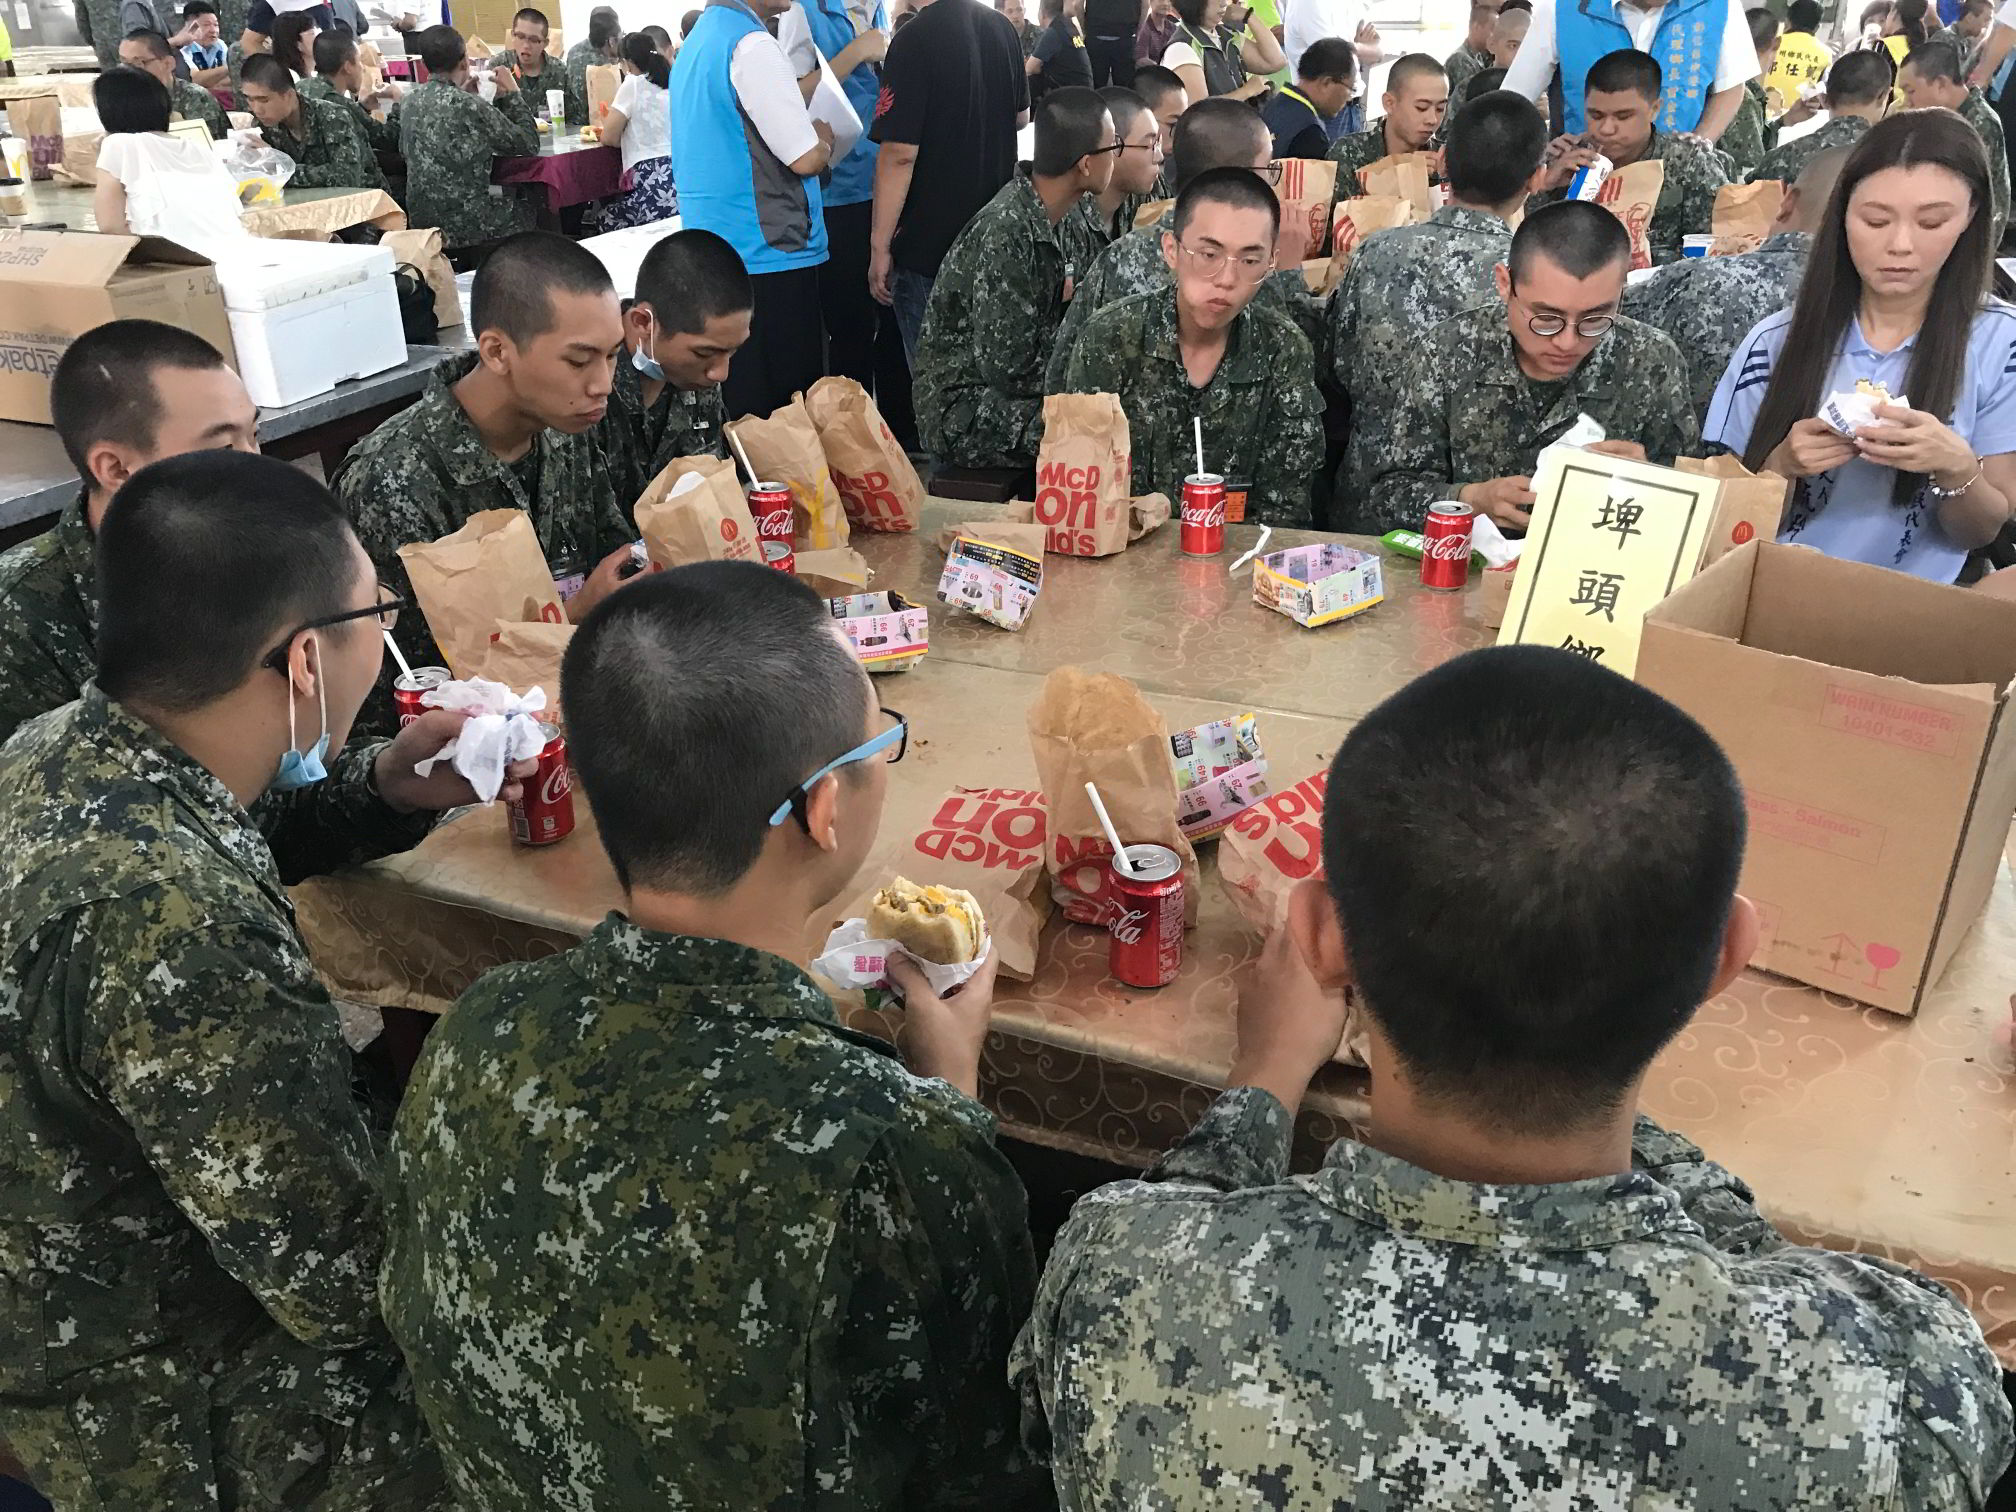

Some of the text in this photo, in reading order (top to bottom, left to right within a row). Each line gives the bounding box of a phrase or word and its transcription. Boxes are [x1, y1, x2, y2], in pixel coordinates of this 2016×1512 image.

[1039, 462, 1100, 490] McD
[1035, 486, 1098, 530] on
[1044, 527, 1097, 556] ld's
[932, 797, 1047, 850] on
[915, 829, 1040, 871] McD
